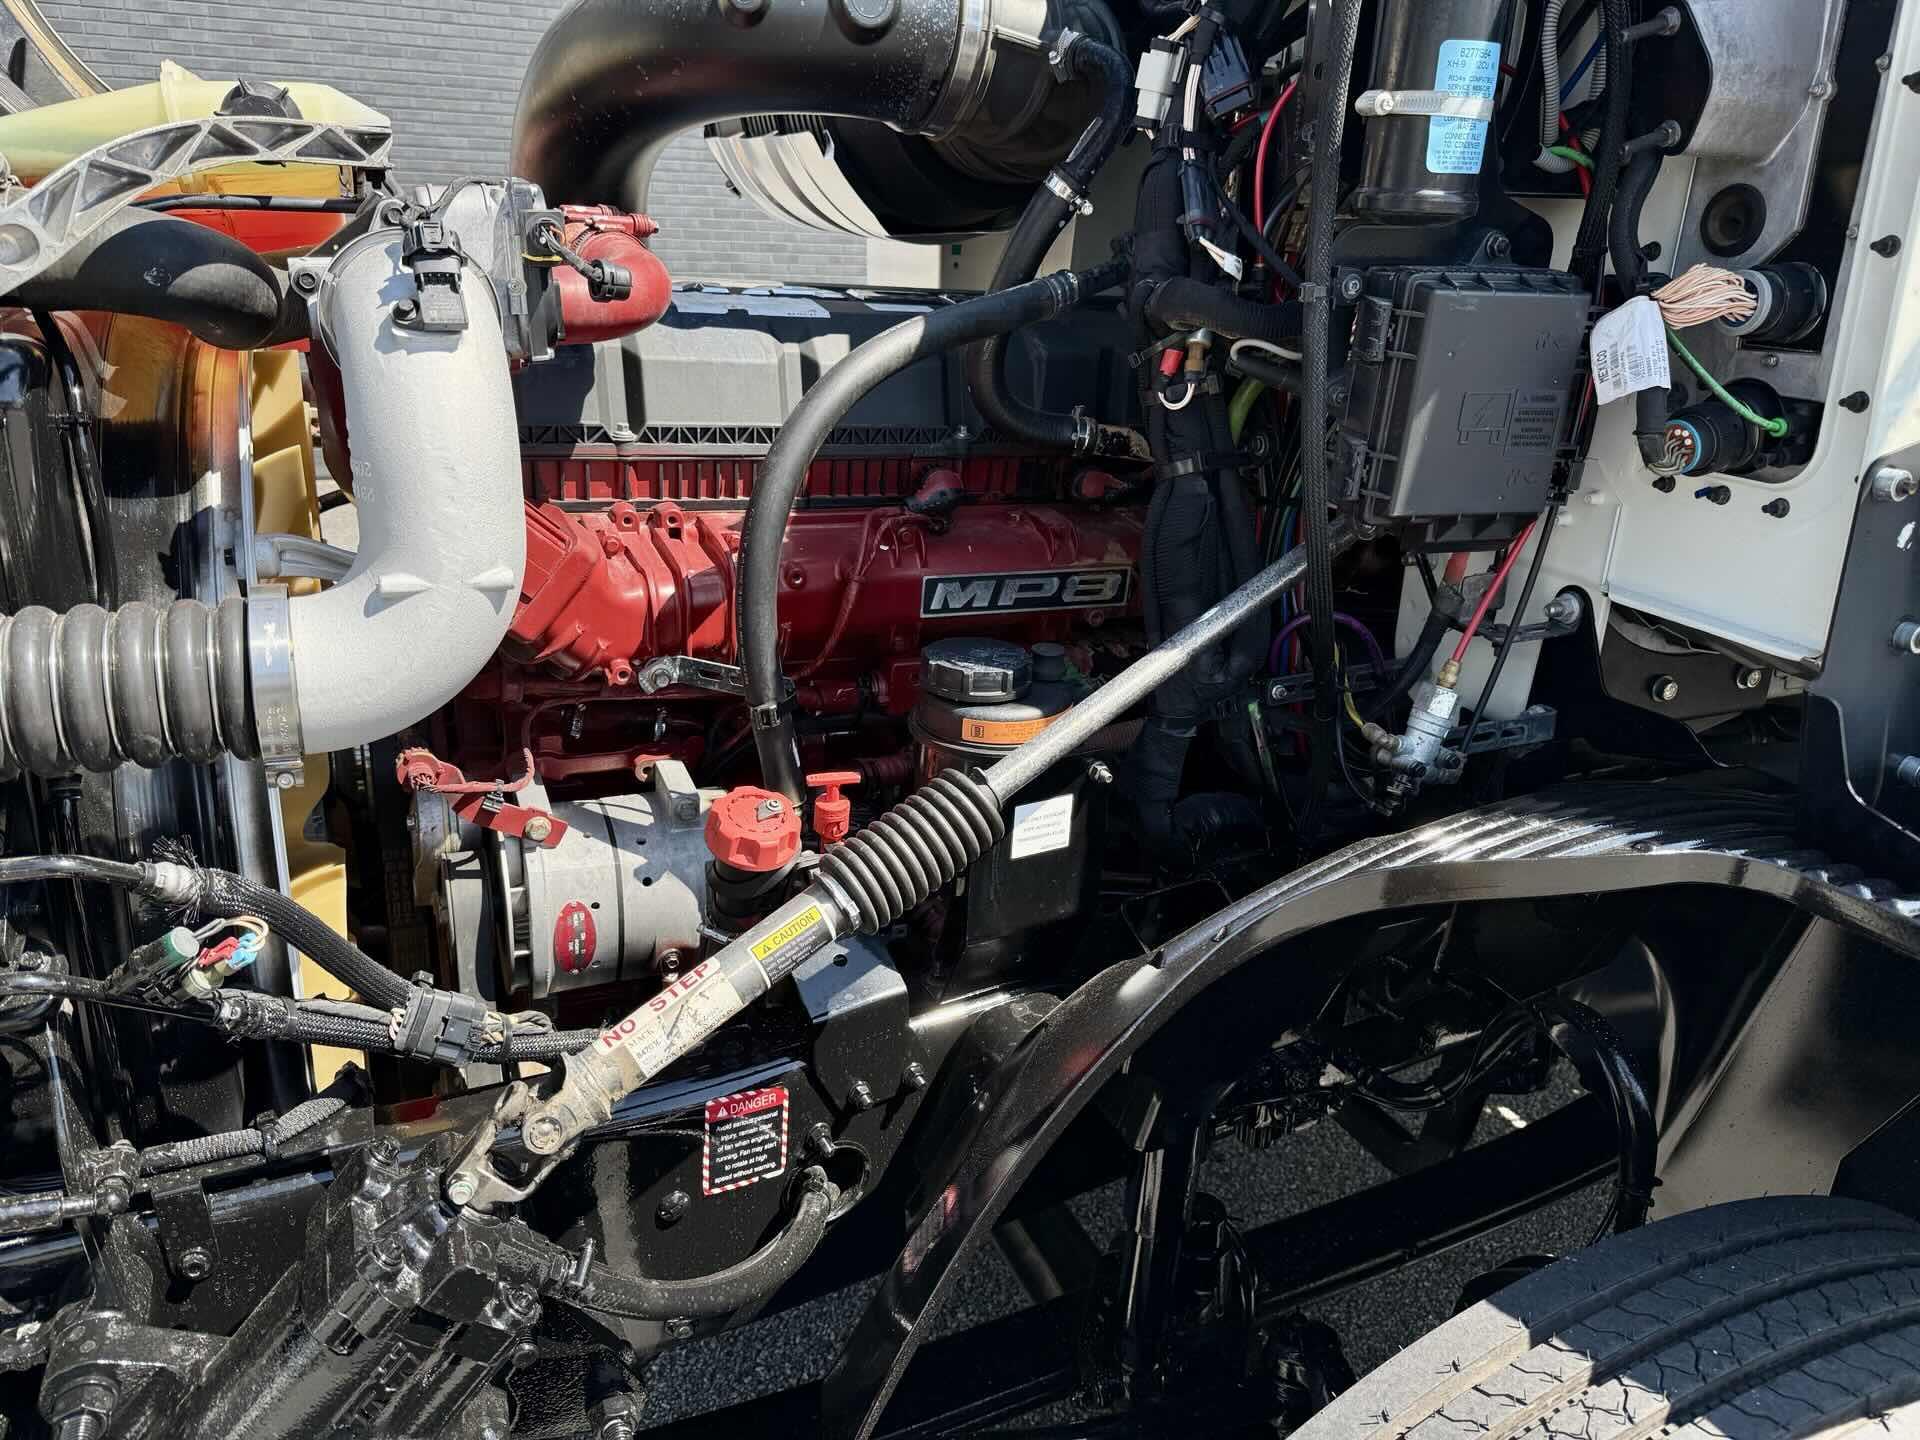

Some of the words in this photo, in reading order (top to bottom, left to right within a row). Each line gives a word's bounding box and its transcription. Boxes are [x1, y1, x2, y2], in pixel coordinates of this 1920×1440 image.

[1597, 349, 1609, 385] MEXICO
[929, 573, 1122, 610] MP8
[772, 912, 816, 946] CAUTION
[602, 1018, 637, 1049] NO
[648, 962, 709, 1013] STEP
[730, 1092, 777, 1114] DANGER
[715, 1122, 732, 1133] Avoid
[717, 1145, 724, 1153] of
[724, 1143, 734, 1151] fan
[734, 1139, 750, 1148] when
[750, 1133, 770, 1145] engine
[740, 1149, 751, 1157] Fan
[751, 1145, 763, 1153] may
[764, 1140, 777, 1150] start
[724, 1164, 731, 1172] to
[731, 1159, 748, 1169] rotate
[755, 1153, 768, 1163] high
[714, 1172, 733, 1184] speed
[732, 1167, 753, 1178] without
